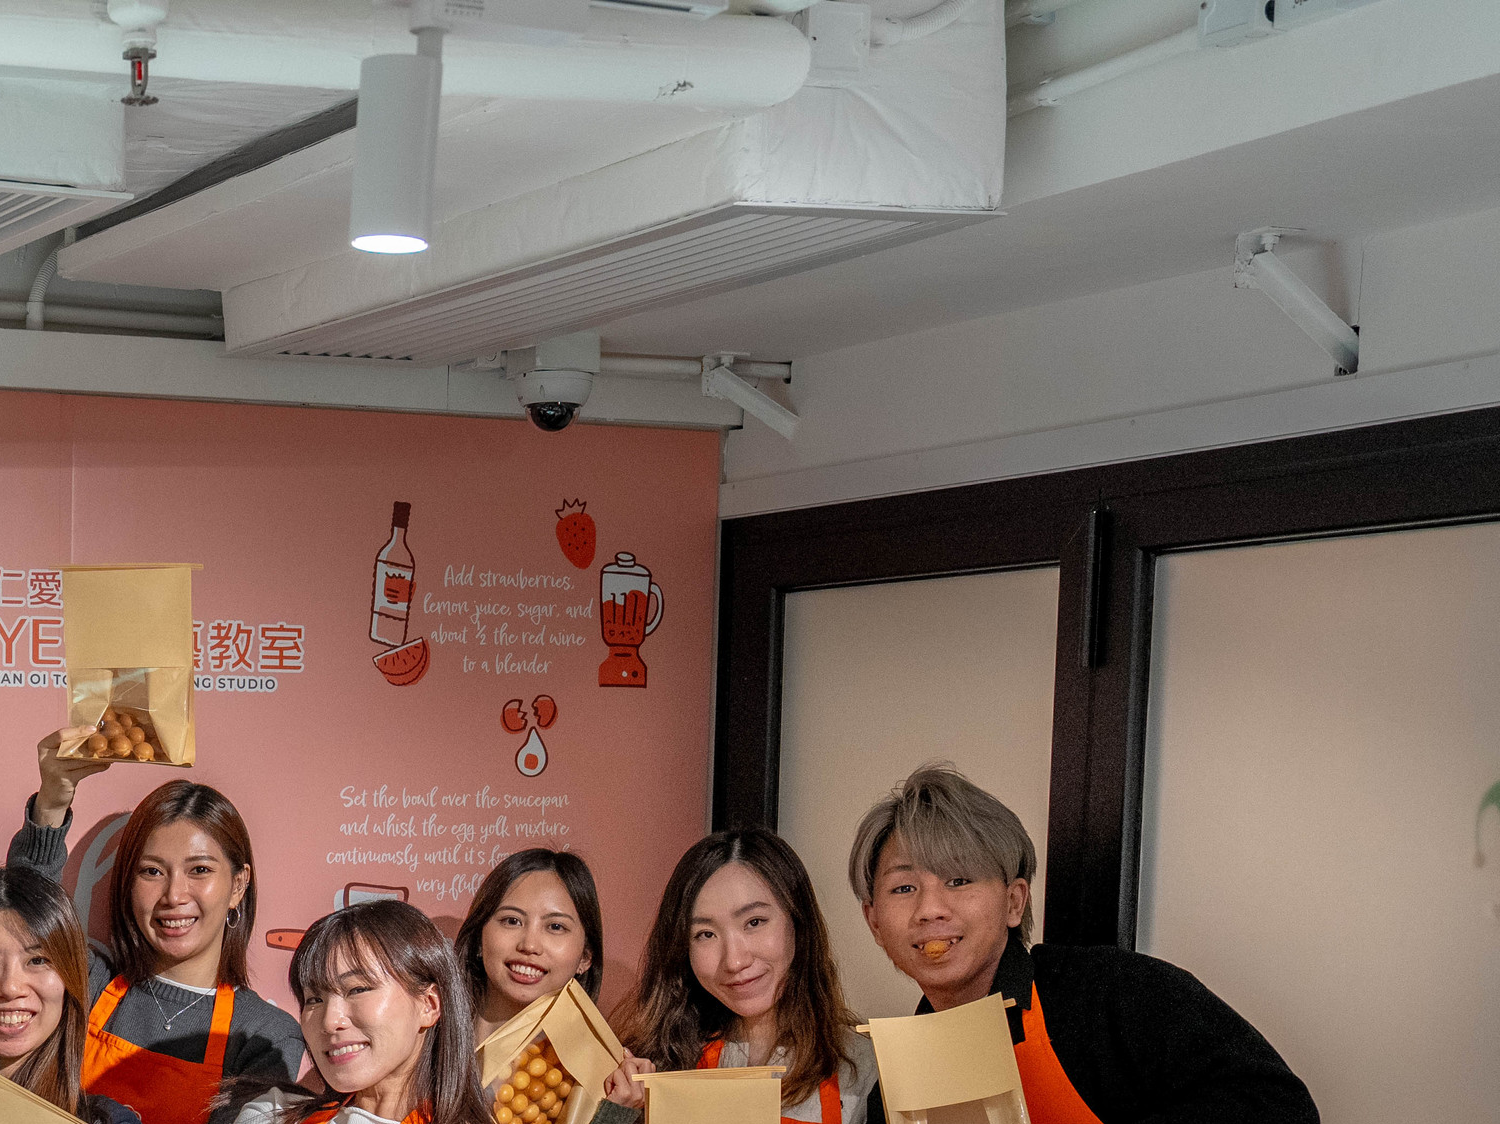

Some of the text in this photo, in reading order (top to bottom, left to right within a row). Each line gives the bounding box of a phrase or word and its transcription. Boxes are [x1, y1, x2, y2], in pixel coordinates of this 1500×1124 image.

[444, 564, 575, 591] Add strawberries,
[423, 592, 594, 625] lemon juice, sugar, and
[430, 623, 468, 645] about
[493, 622, 518, 646] the
[521, 625, 546, 646] red
[550, 629, 586, 646] wine
[463, 652, 552, 675] to a blender
[30, 673, 46, 685] OI
[218, 678, 276, 690] STUDIO
[339, 784, 570, 816] Set the bowl over the saucepan
[339, 813, 570, 844] and whisk the egg yolk mixture
[326, 843, 419, 873] continuously
[424, 843, 461, 866] until
[464, 844, 485, 866] it's
[416, 876, 449, 901] very
